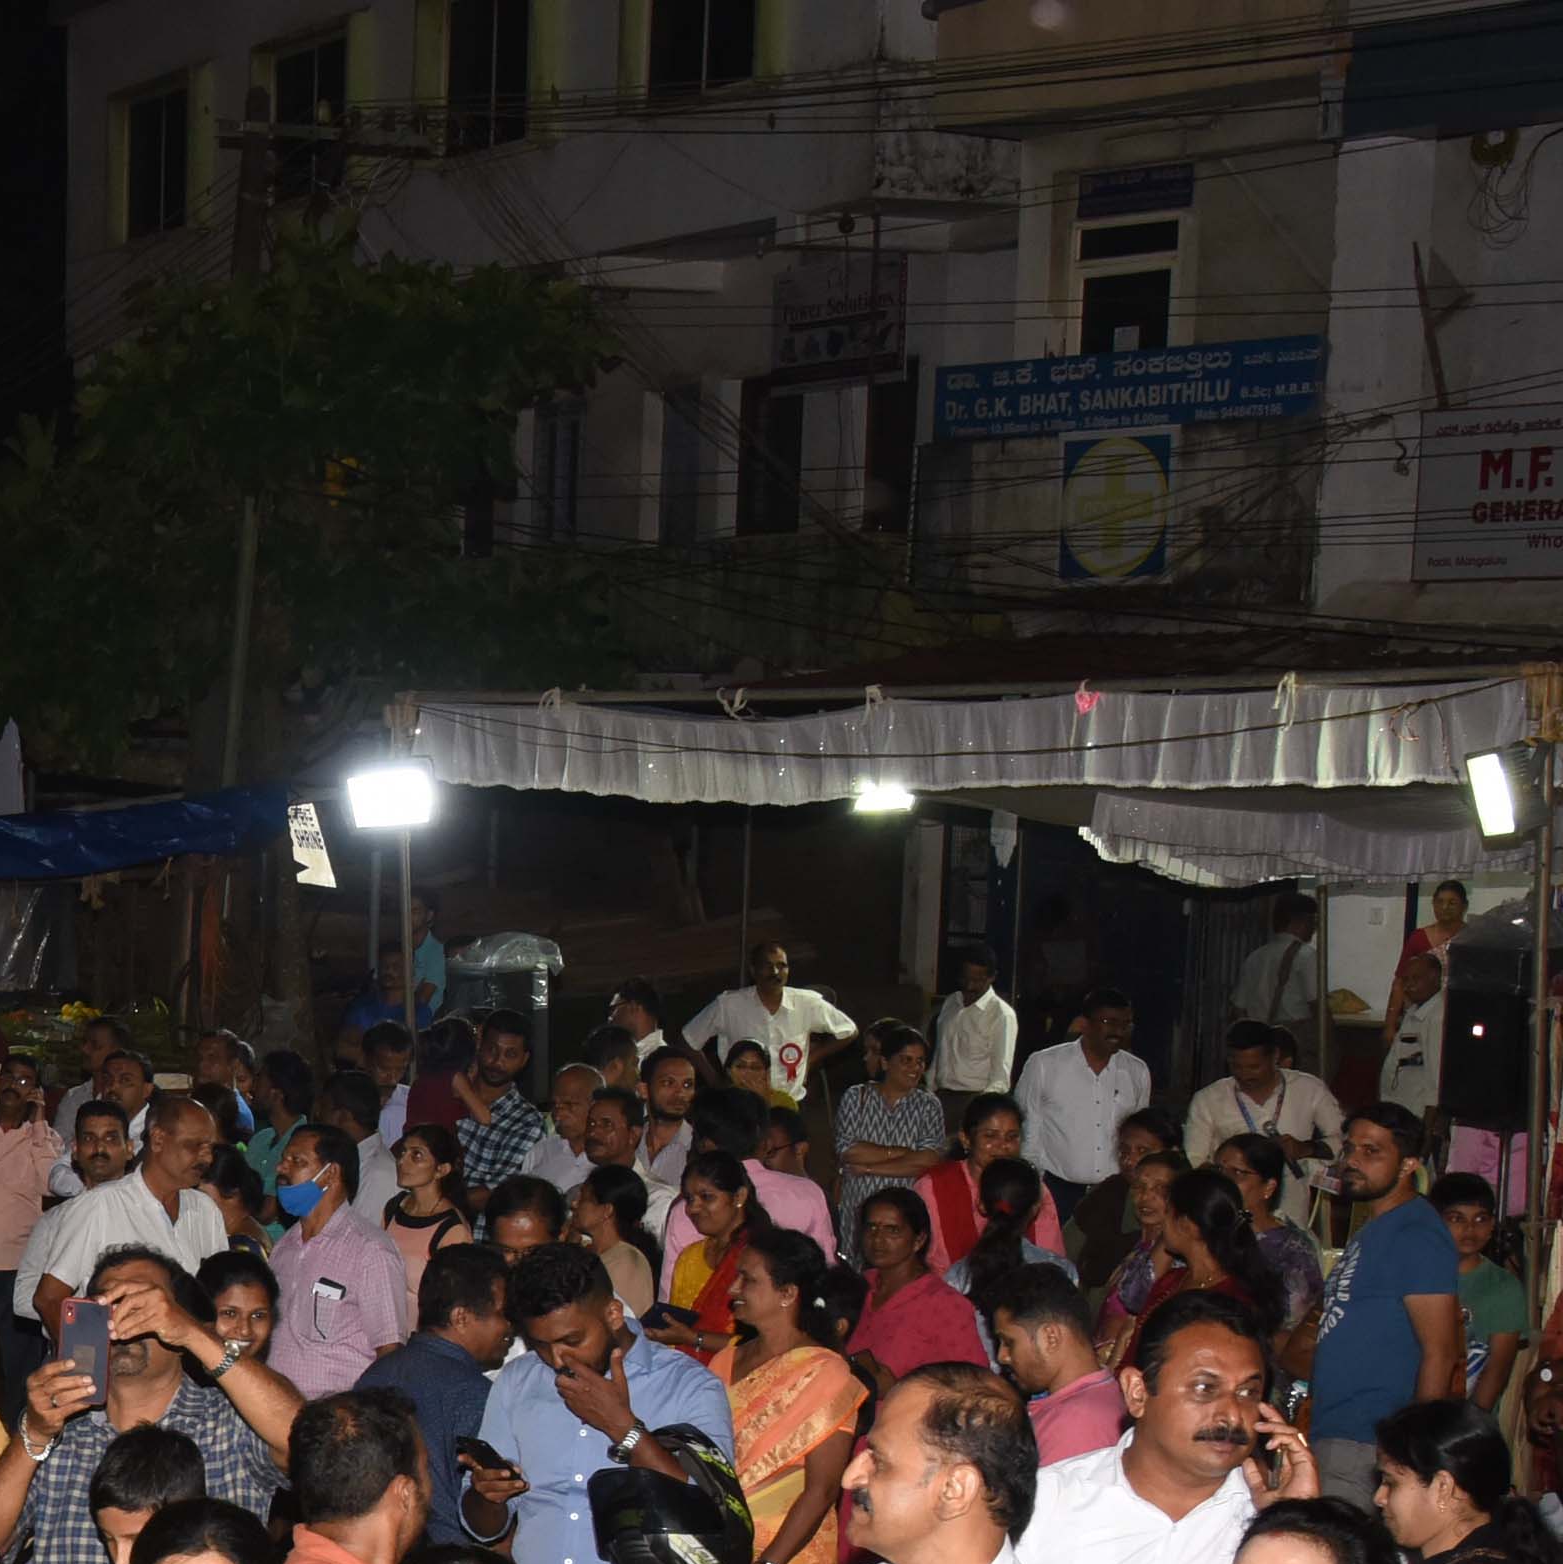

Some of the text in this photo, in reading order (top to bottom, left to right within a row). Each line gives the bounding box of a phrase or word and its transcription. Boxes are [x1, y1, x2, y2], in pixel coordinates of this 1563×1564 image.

[944, 378, 1231, 420] Dr. G.K. BHAT, SANKABITHILU
[1478, 445, 1555, 492] M.F.
